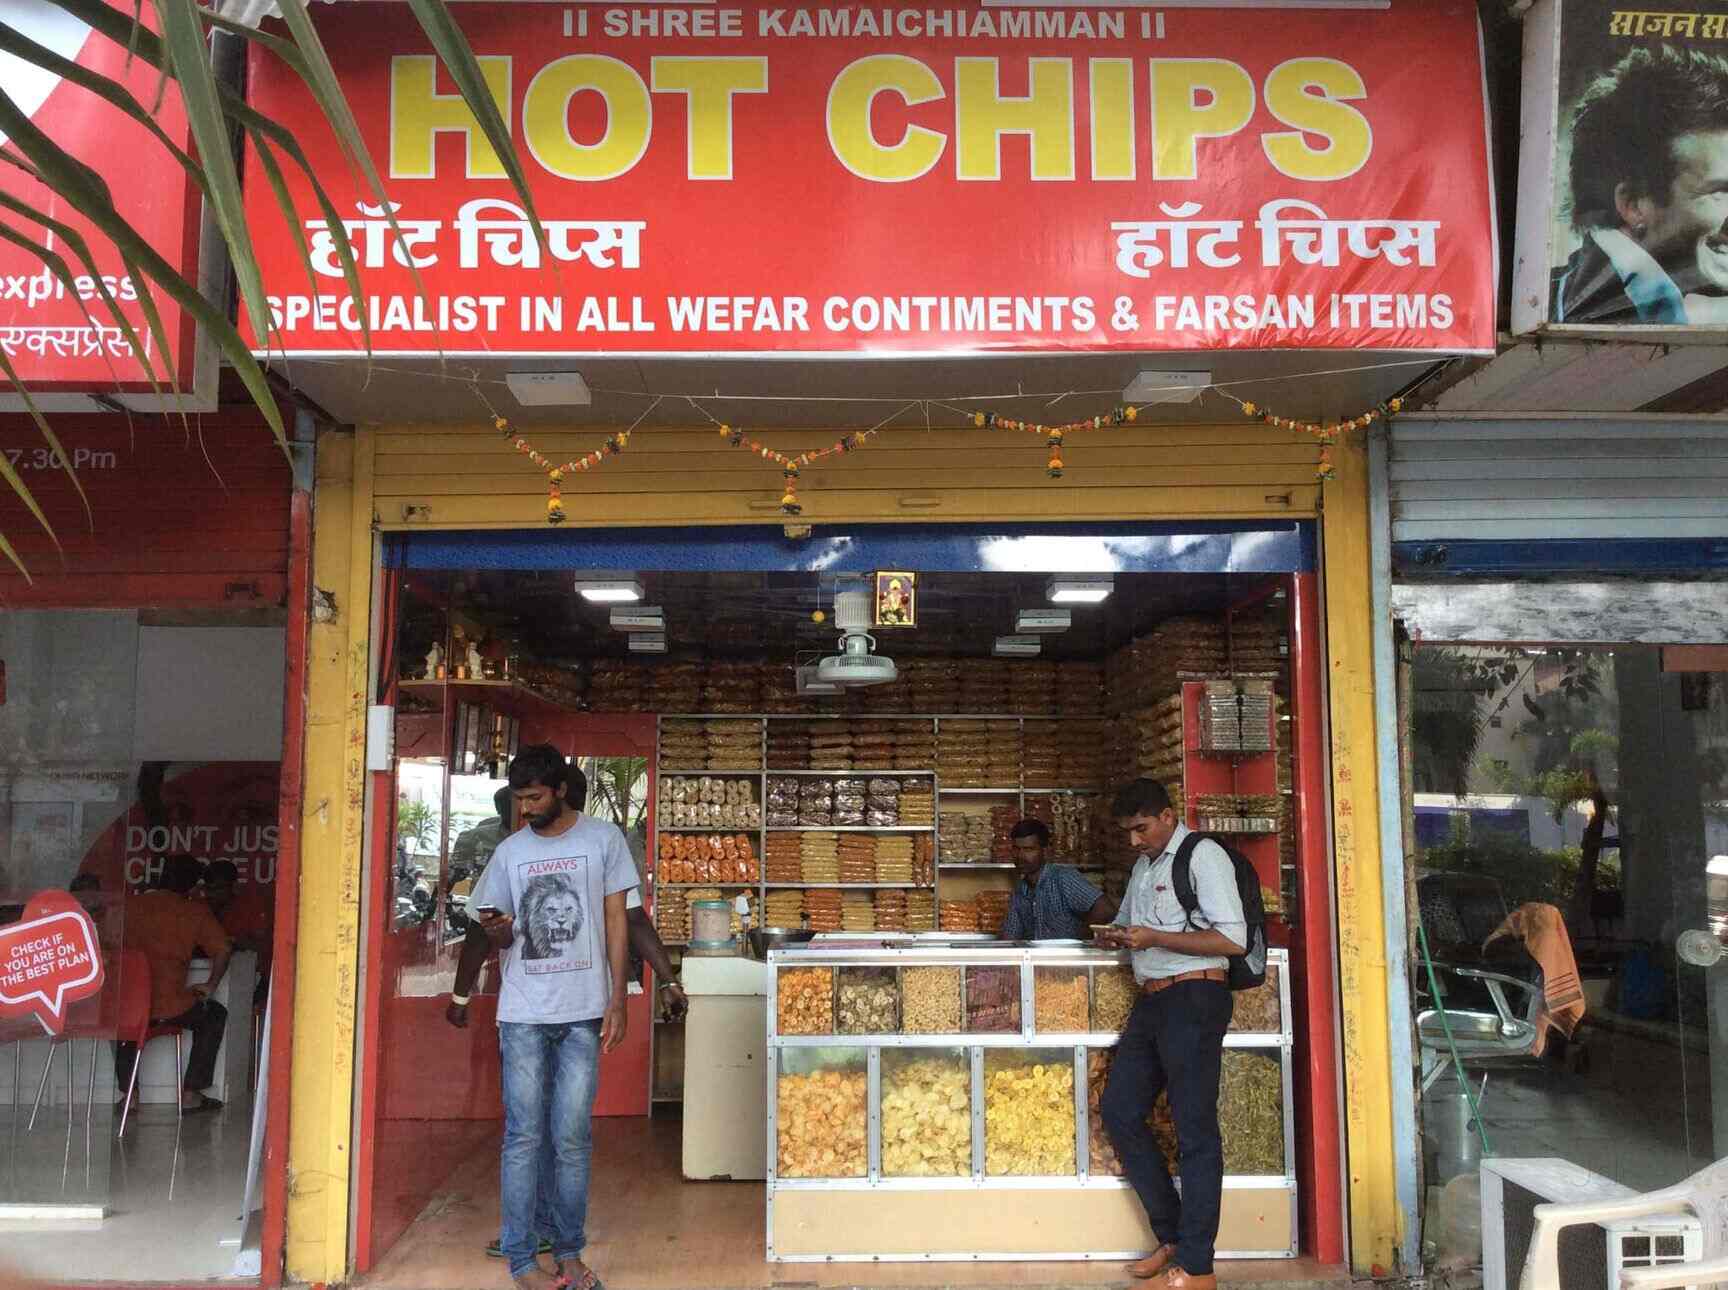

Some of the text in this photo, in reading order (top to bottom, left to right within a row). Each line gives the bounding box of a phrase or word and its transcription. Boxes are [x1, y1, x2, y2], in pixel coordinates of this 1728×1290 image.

[603, 9, 743, 37] SHREE
[758, 9, 1125, 39] KAMAICHIAMMAN
[1609, 11, 1700, 38] साजन
[388, 54, 1374, 182] HOT CHIPS
[305, 198, 648, 278] हॉट चिप्स
[1110, 198, 1442, 279] हॉट चिप्स
[265, 293, 1455, 333] SPECIALIST IN ALL WEFAR CONTIMENTS & FARSAN ITEMS
[74, 448, 116, 470] Pm
[126, 825, 219, 852] DON'T
[527, 859, 577, 875] ALWAYS
[5, 942, 76, 972] YOU ARE ON
[11, 933, 64, 957] CHECK IF
[1, 953, 89, 986] THE BEST PLAN
